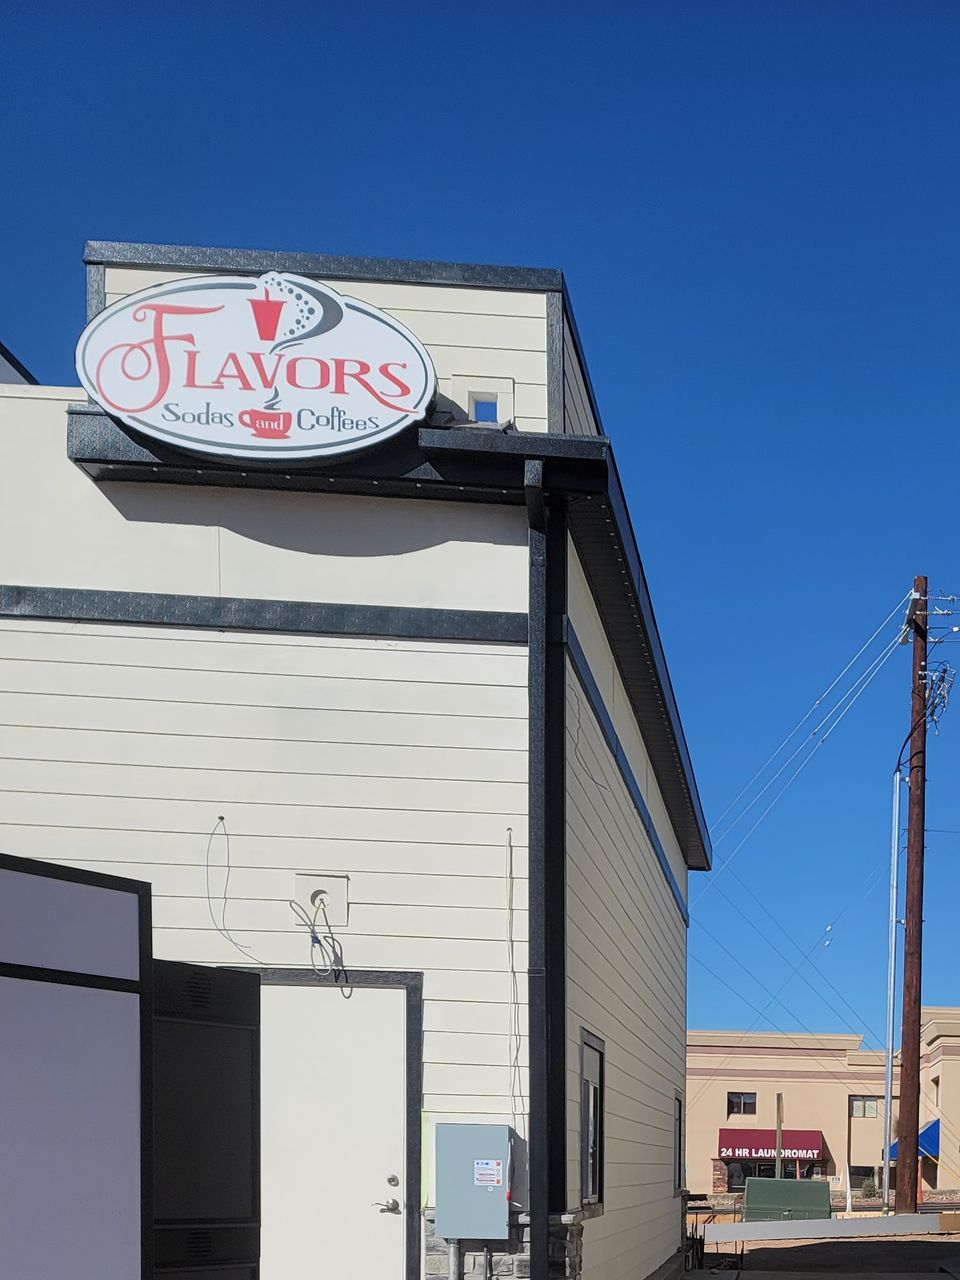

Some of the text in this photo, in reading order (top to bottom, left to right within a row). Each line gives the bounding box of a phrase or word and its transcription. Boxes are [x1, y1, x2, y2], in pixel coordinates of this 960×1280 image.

[161, 399, 380, 432] Sodas and Coffees
[720, 1148, 732, 1157] 24
[735, 1148, 749, 1157] HR
